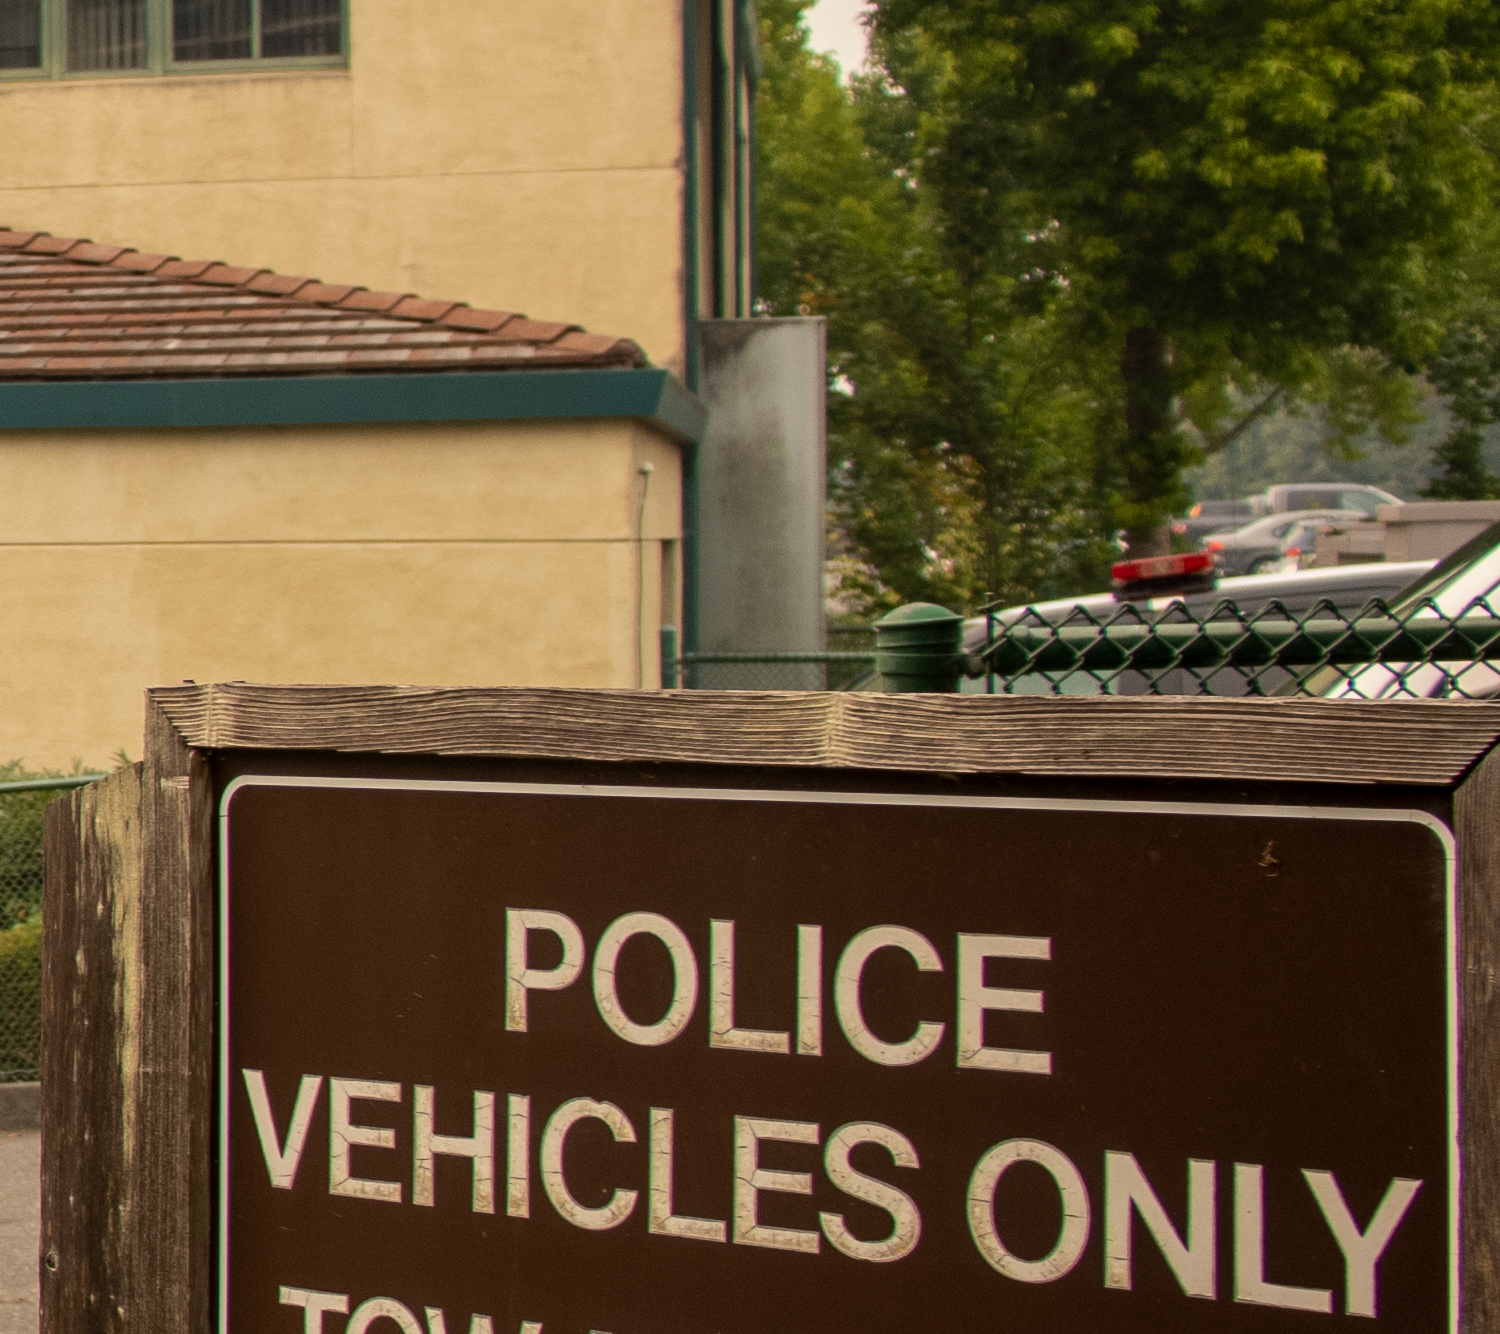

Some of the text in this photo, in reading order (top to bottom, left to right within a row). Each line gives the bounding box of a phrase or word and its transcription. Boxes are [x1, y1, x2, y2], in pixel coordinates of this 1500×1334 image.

[505, 906, 1052, 1073] POLICE
[242, 1068, 1423, 1318] VEHICLES ONLY
